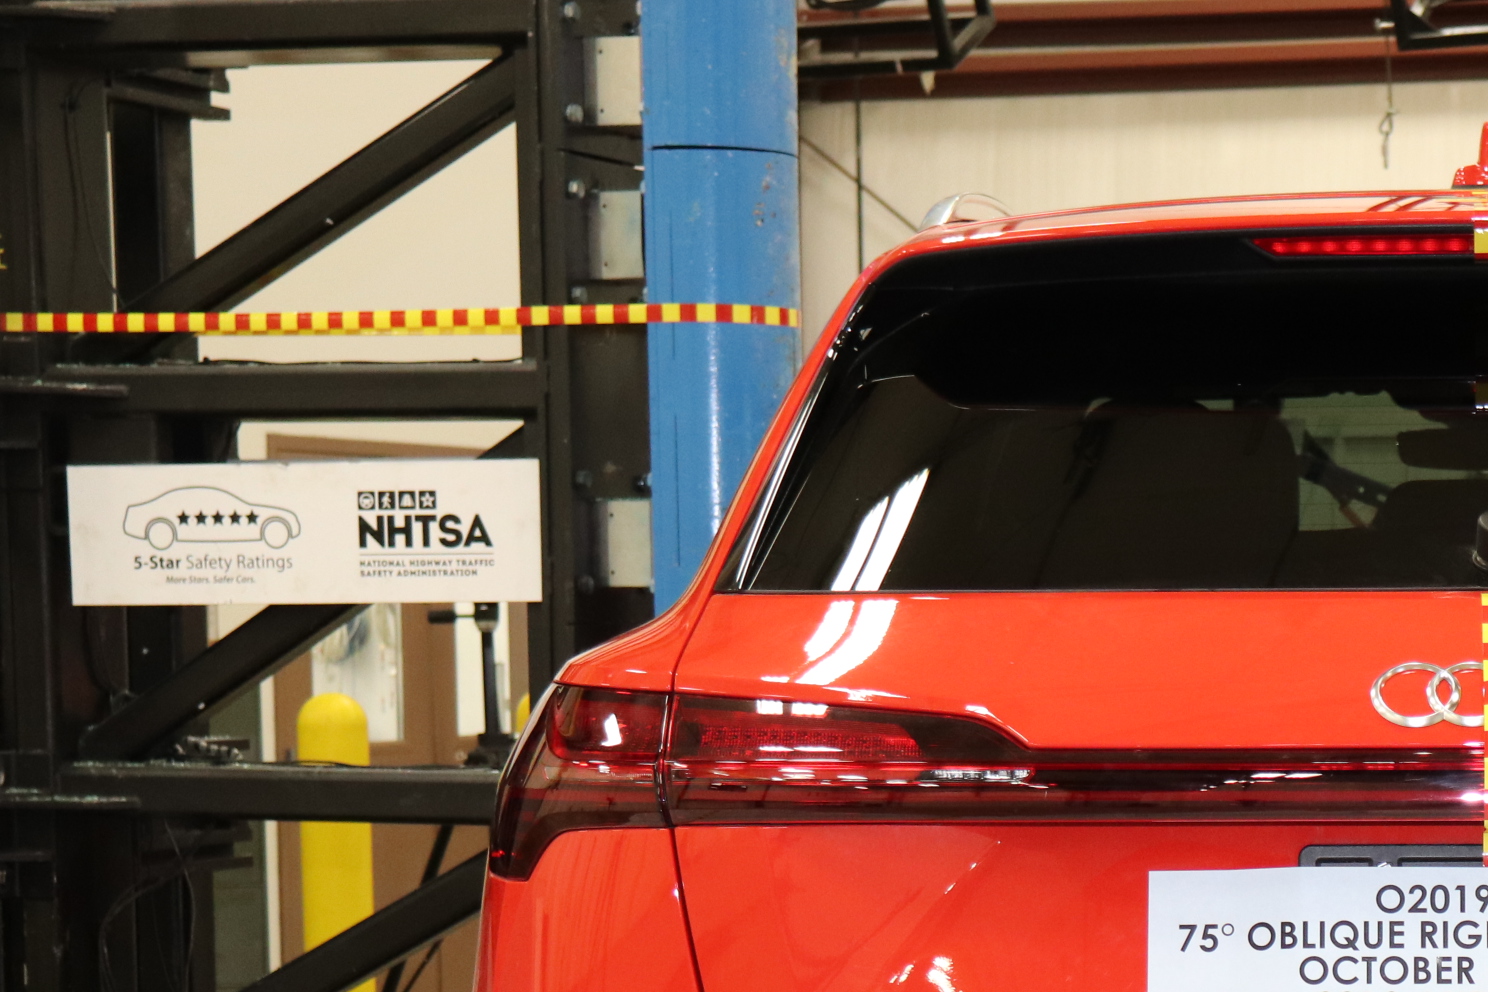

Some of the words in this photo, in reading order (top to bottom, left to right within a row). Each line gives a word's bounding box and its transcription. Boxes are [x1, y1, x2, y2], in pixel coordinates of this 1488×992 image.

[358, 514, 493, 548] NHTSA
[134, 555, 182, 570] 5-Star
[186, 554, 232, 573] Safety
[236, 554, 293, 573] Ratings
[359, 559, 406, 567] NATIONAL
[410, 559, 453, 567] HIGHWAY
[456, 559, 495, 567] TRAFFIC
[165, 575, 187, 584] More
[213, 575, 235, 584] Safer
[360, 569, 393, 577] SAFETY
[396, 569, 478, 577] ADMINISTRATION
[1178, 923, 1235, 953] 75°
[1247, 921, 1405, 950] OBLIQUE
[1299, 955, 1475, 985] OCTOBER
